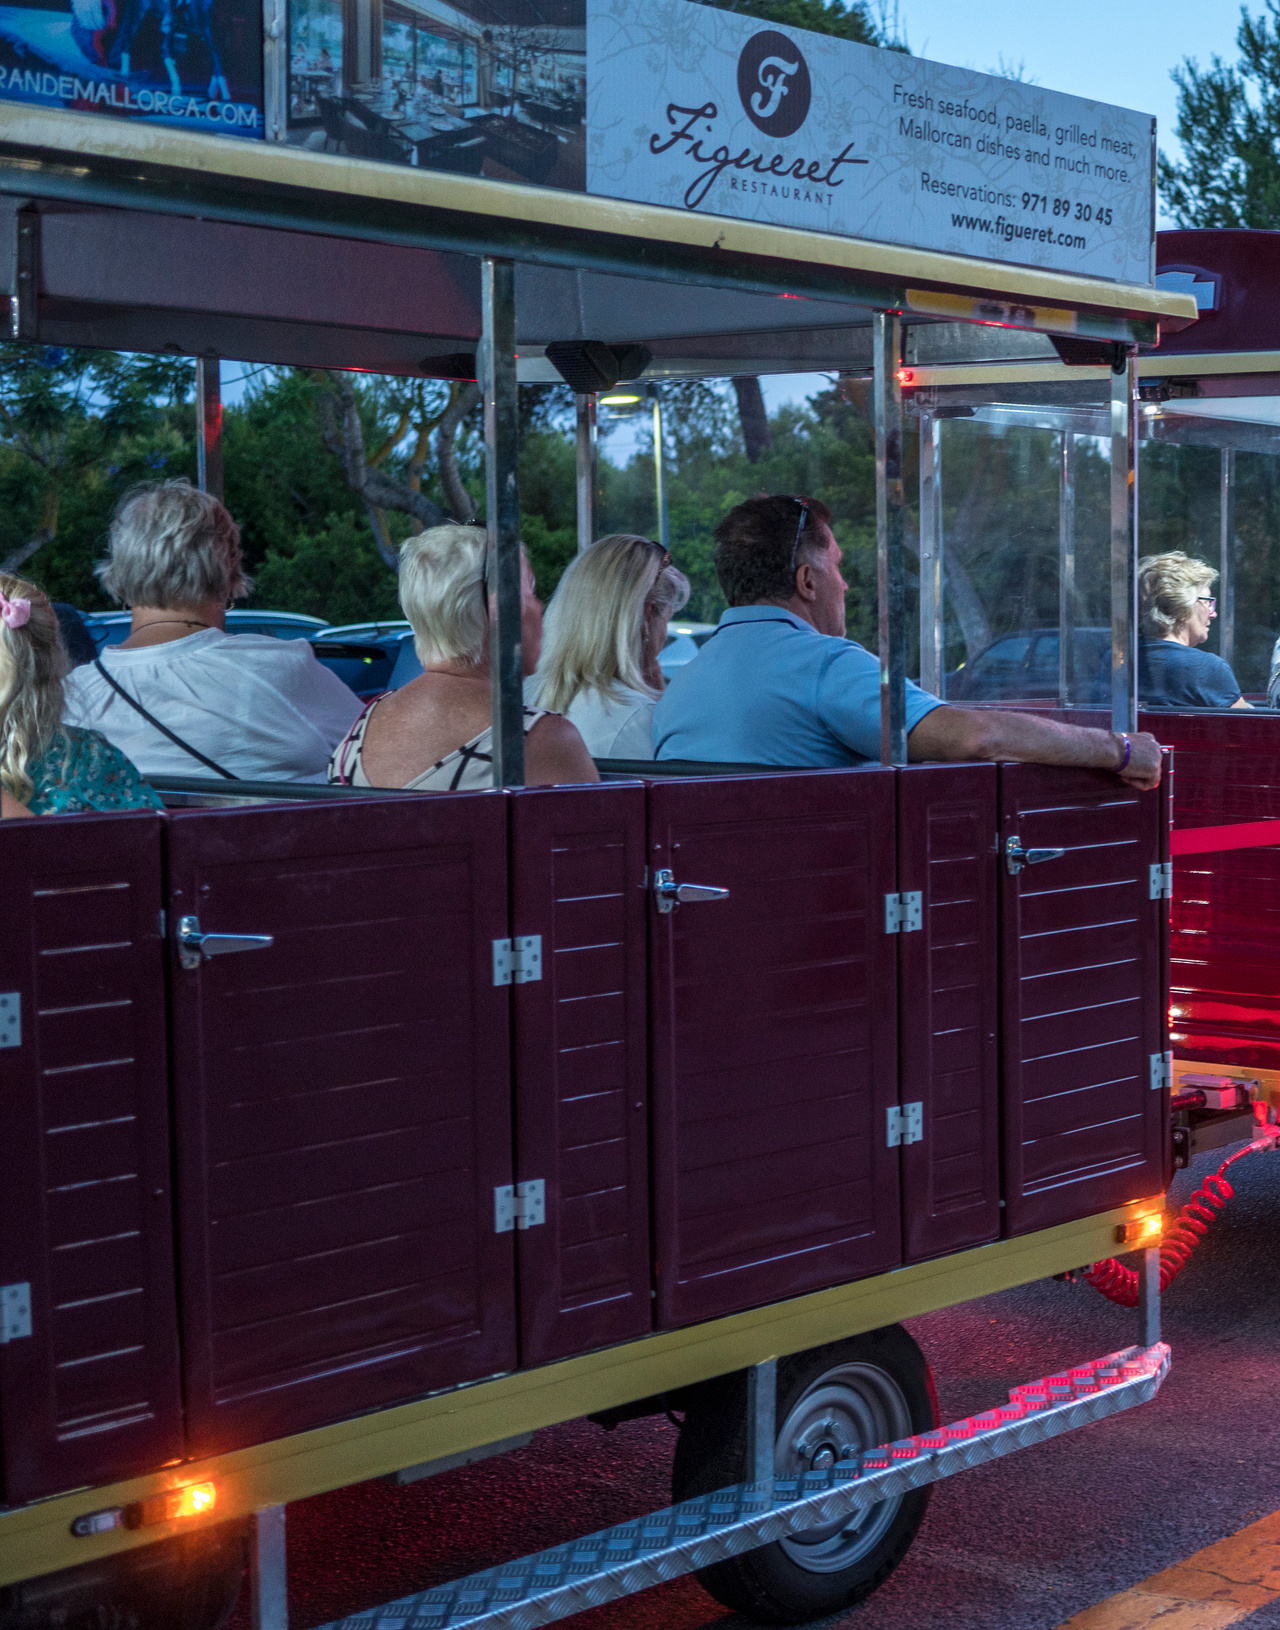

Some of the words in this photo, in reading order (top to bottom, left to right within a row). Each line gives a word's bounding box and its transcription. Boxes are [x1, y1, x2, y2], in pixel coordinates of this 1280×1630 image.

[893, 84, 933, 112] Fresh
[938, 99, 1001, 130] seafood,
[1006, 114, 1051, 140] paella,
[1055, 124, 1097, 146] grilled
[1101, 135, 1137, 160] meat,
[899, 117, 972, 151] Mallorcan
[976, 134, 1021, 160] dishes
[1024, 147, 1050, 167] and
[1054, 155, 1090, 175] much
[1094, 164, 1132, 184] more.
[650, 101, 869, 210] Figueret
[730, 177, 834, 206] RESTAURANT
[921, 172, 1016, 209] Reservations:
[1021, 191, 1047, 214] 971
[1052, 198, 1070, 218] 89
[1074, 202, 1092, 222] 30
[1095, 207, 1113, 226] 45
[951, 212, 1086, 250] www.figueret.com
